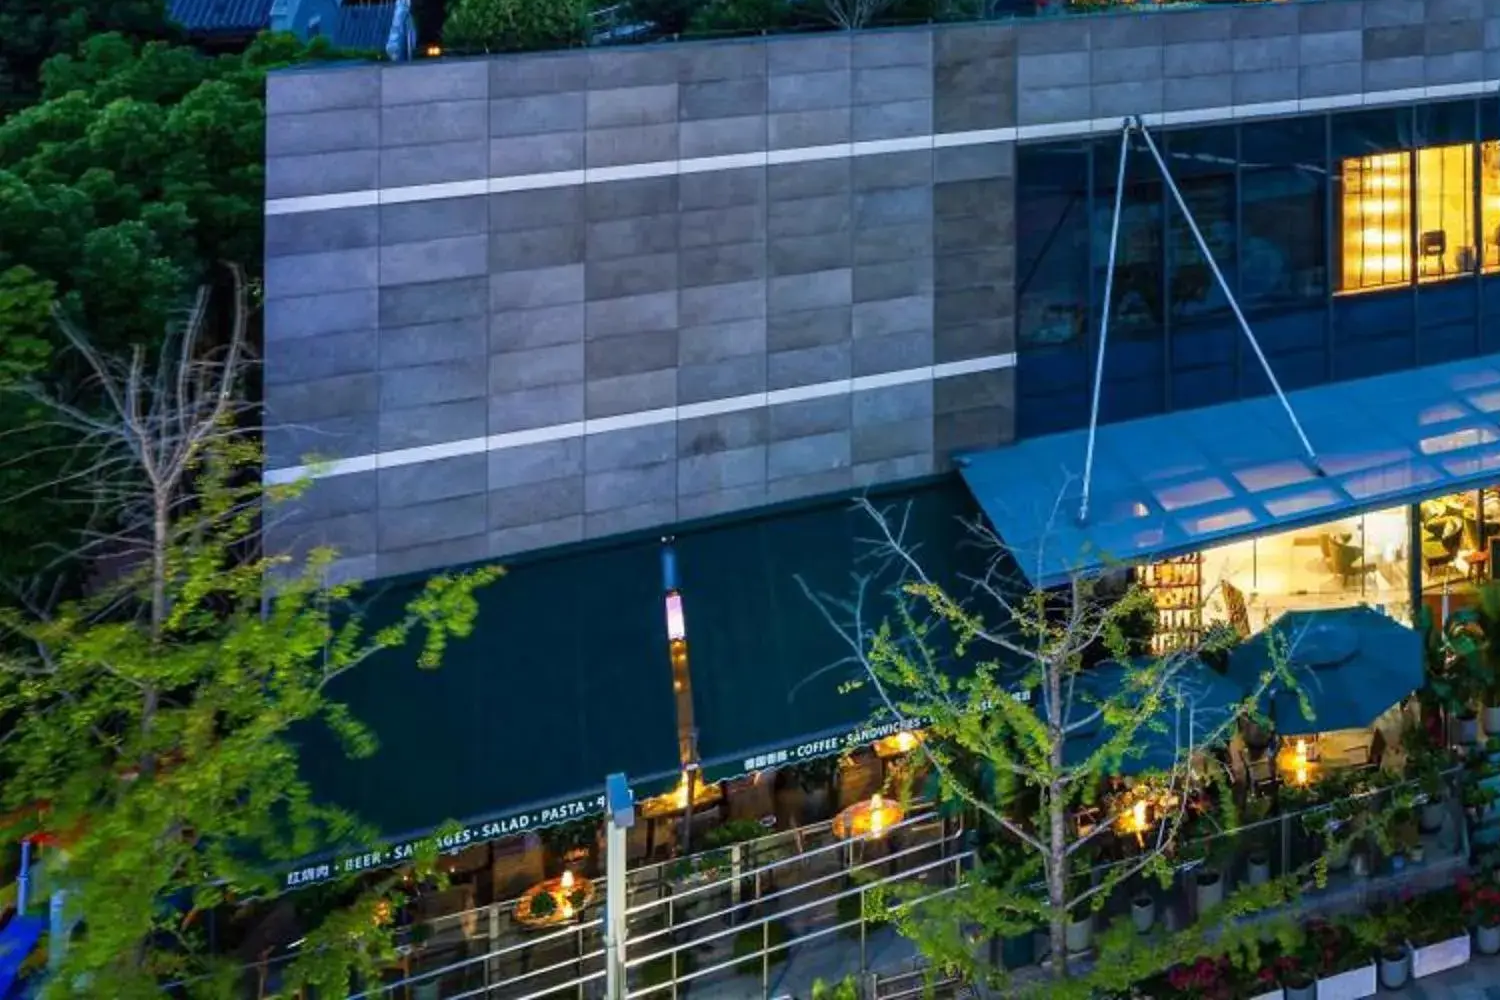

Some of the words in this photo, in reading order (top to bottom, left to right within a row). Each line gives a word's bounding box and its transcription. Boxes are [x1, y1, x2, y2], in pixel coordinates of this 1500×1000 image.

[797, 737, 838, 757] COFFEE
[344, 852, 382, 870] BEER
[481, 815, 529, 837] SALAD
[541, 801, 585, 823] PASTA
